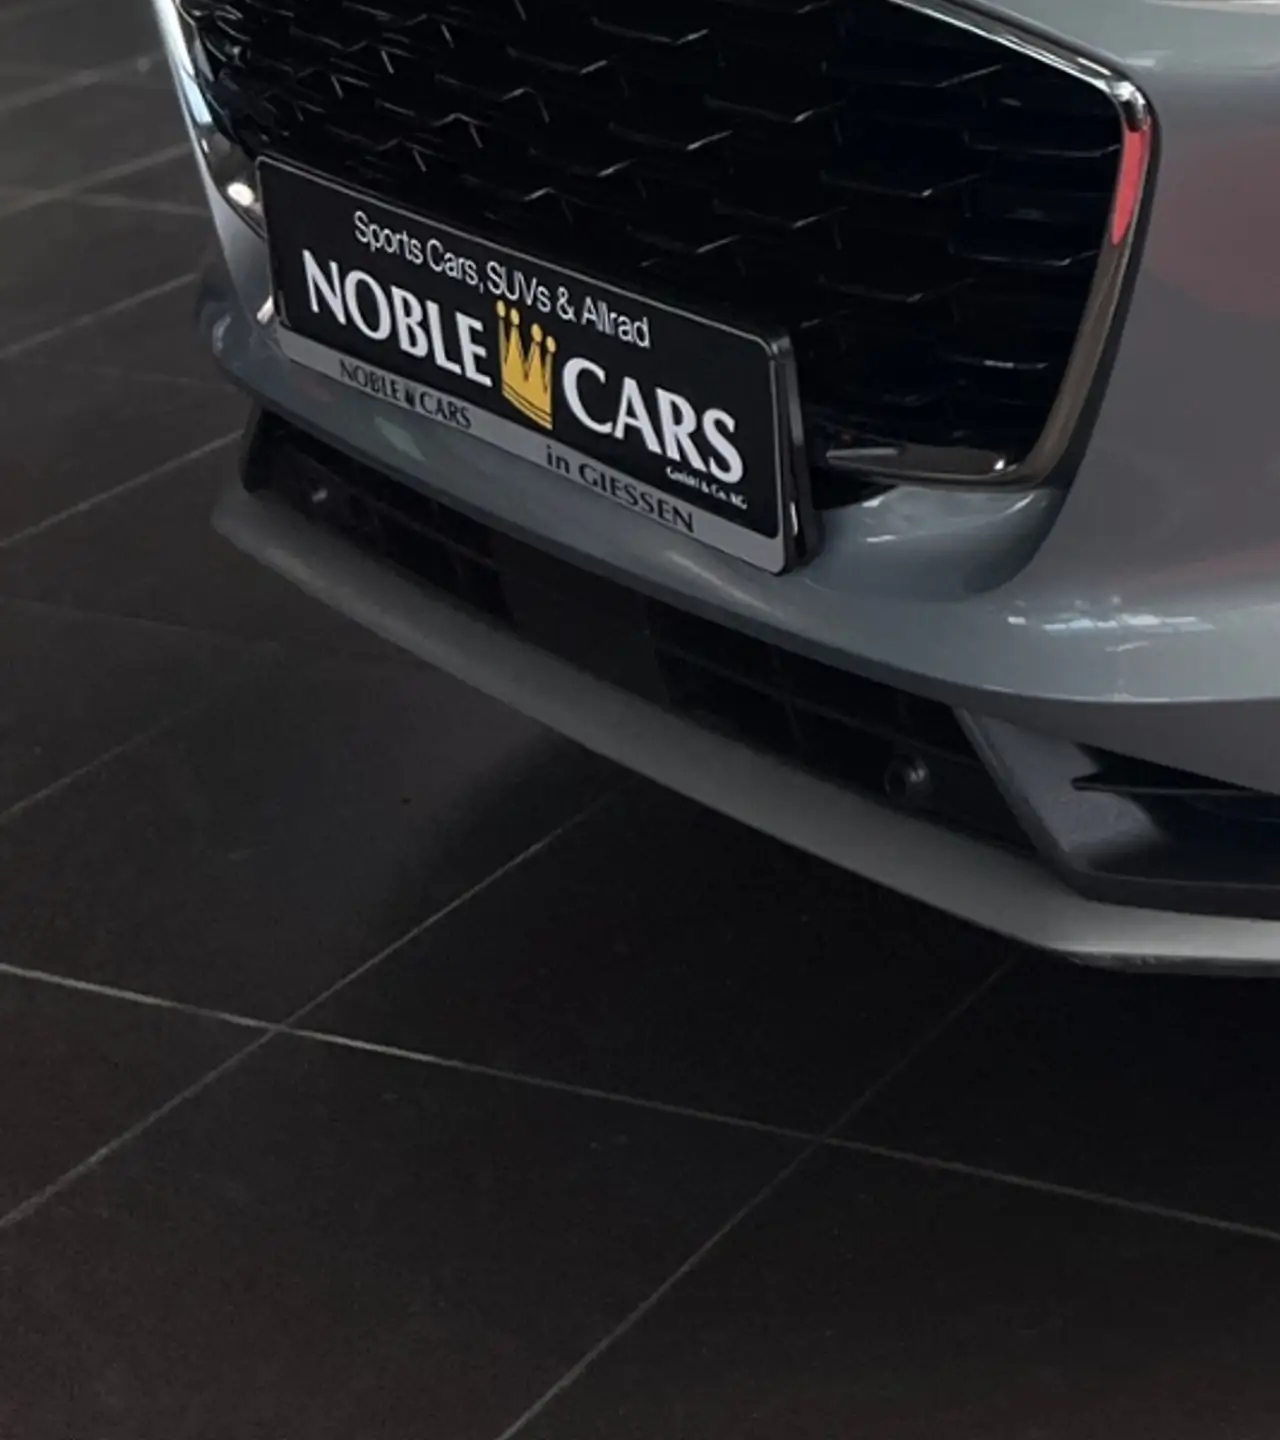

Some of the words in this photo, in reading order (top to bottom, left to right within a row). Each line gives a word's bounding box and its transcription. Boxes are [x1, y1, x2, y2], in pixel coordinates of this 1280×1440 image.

[354, 210, 424, 265] Sports
[426, 238, 484, 294] Cars,
[486, 260, 551, 313] SUVs
[556, 286, 577, 322] &
[581, 296, 651, 349] Allrad
[302, 248, 493, 388] NOBLE
[562, 356, 744, 485] CARS
[338, 358, 401, 402] NOBLE
[420, 390, 472, 430] CARS
[546, 443, 571, 475] in
[578, 462, 695, 534] GIESSEN
